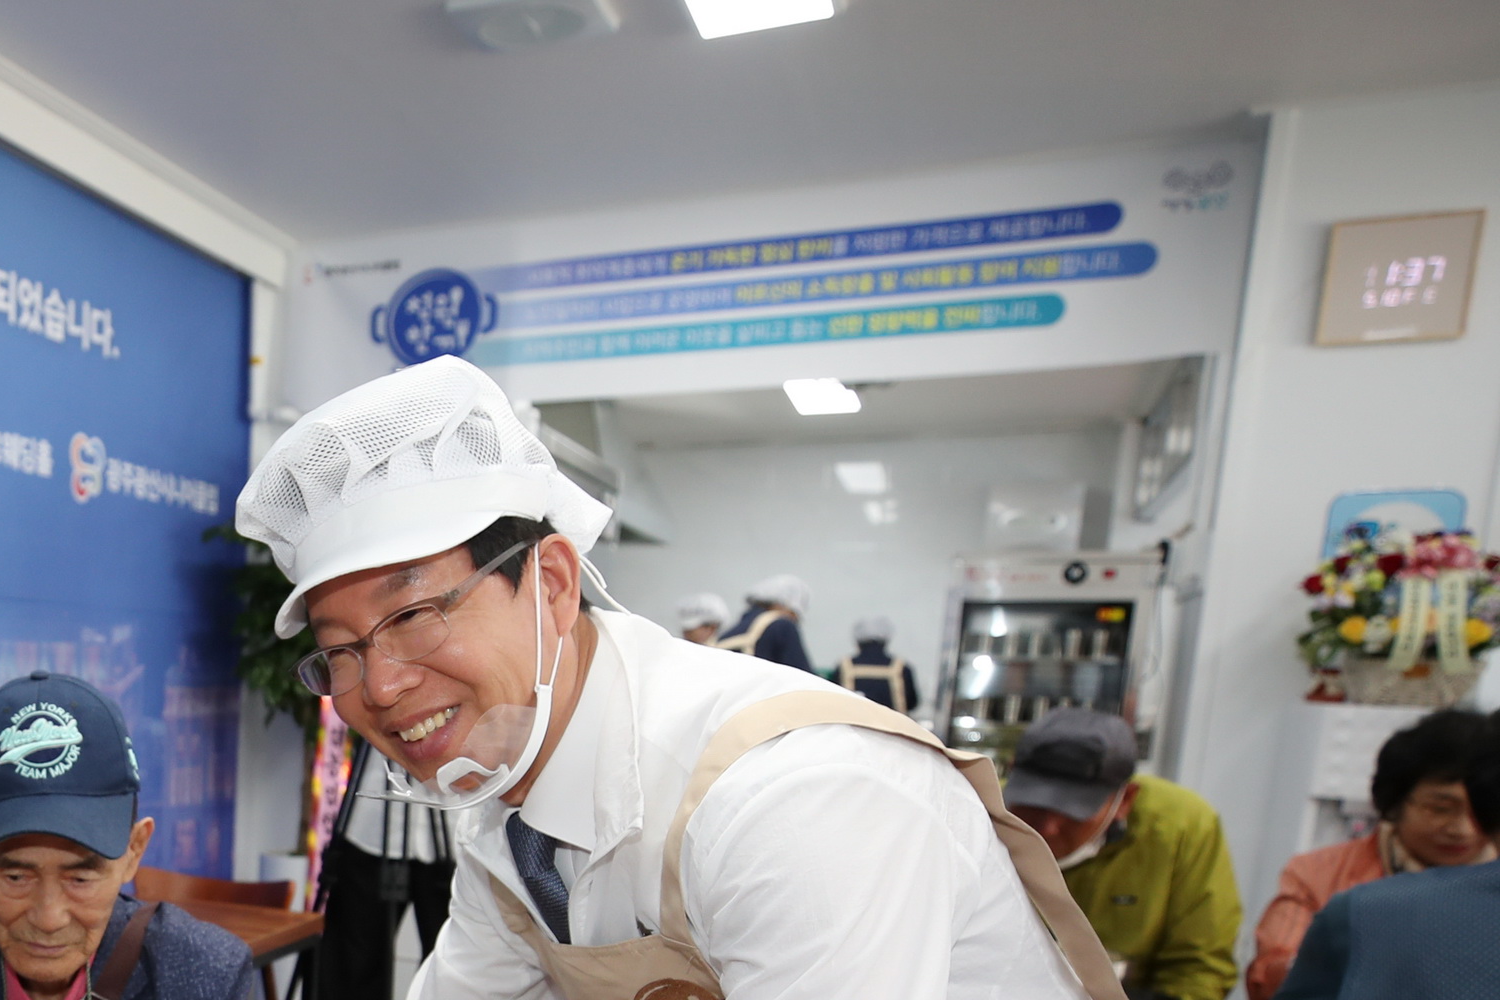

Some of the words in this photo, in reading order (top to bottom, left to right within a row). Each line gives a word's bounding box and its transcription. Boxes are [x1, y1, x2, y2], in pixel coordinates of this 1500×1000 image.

[10, 703, 37, 724] NEW
[40, 702, 75, 722] YORK
[15, 763, 48, 779] TEAM
[49, 744, 81, 778] MAJOR
